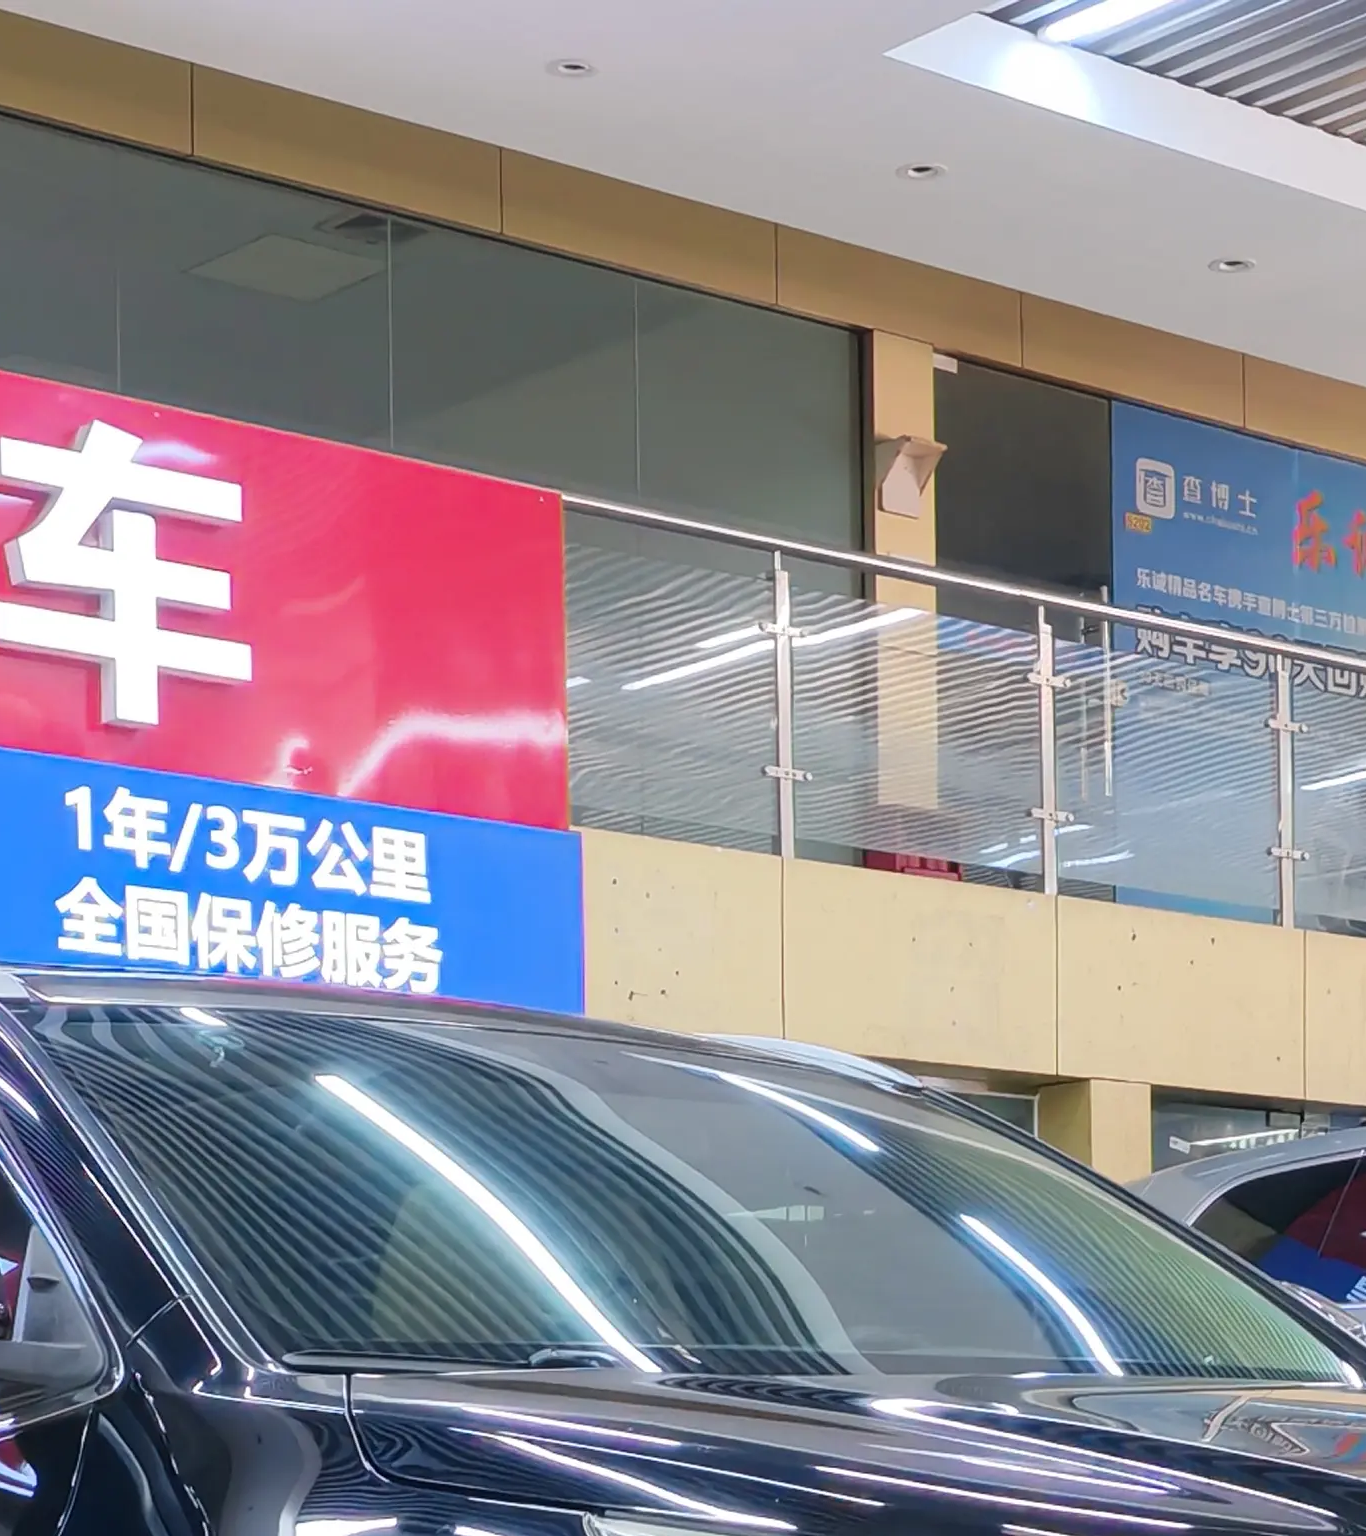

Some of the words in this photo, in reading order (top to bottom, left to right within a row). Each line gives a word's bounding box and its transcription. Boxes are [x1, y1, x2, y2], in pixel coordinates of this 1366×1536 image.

[1182, 475, 1257, 519] 查博士
[64, 785, 433, 905] 1年/3万公里
[55, 876, 443, 996] 全国保修服务
